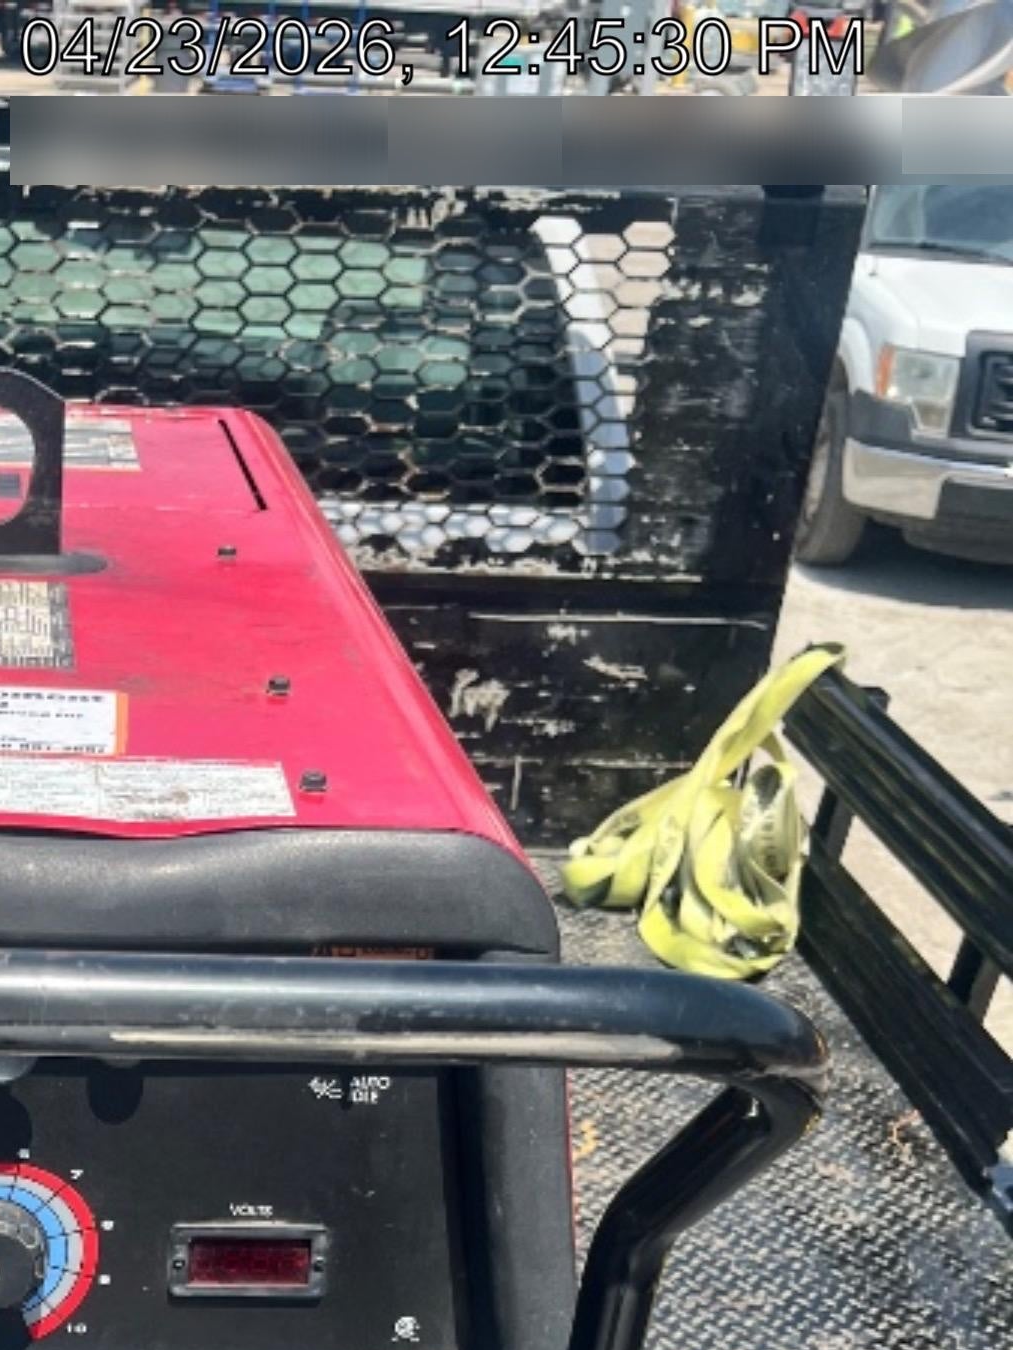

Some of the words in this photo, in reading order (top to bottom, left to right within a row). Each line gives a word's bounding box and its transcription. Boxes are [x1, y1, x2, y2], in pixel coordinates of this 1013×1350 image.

[350, 1076, 391, 1090] AUTO
[229, 1203, 273, 1216] VOLTS
[67, 1323, 87, 1334] 10
